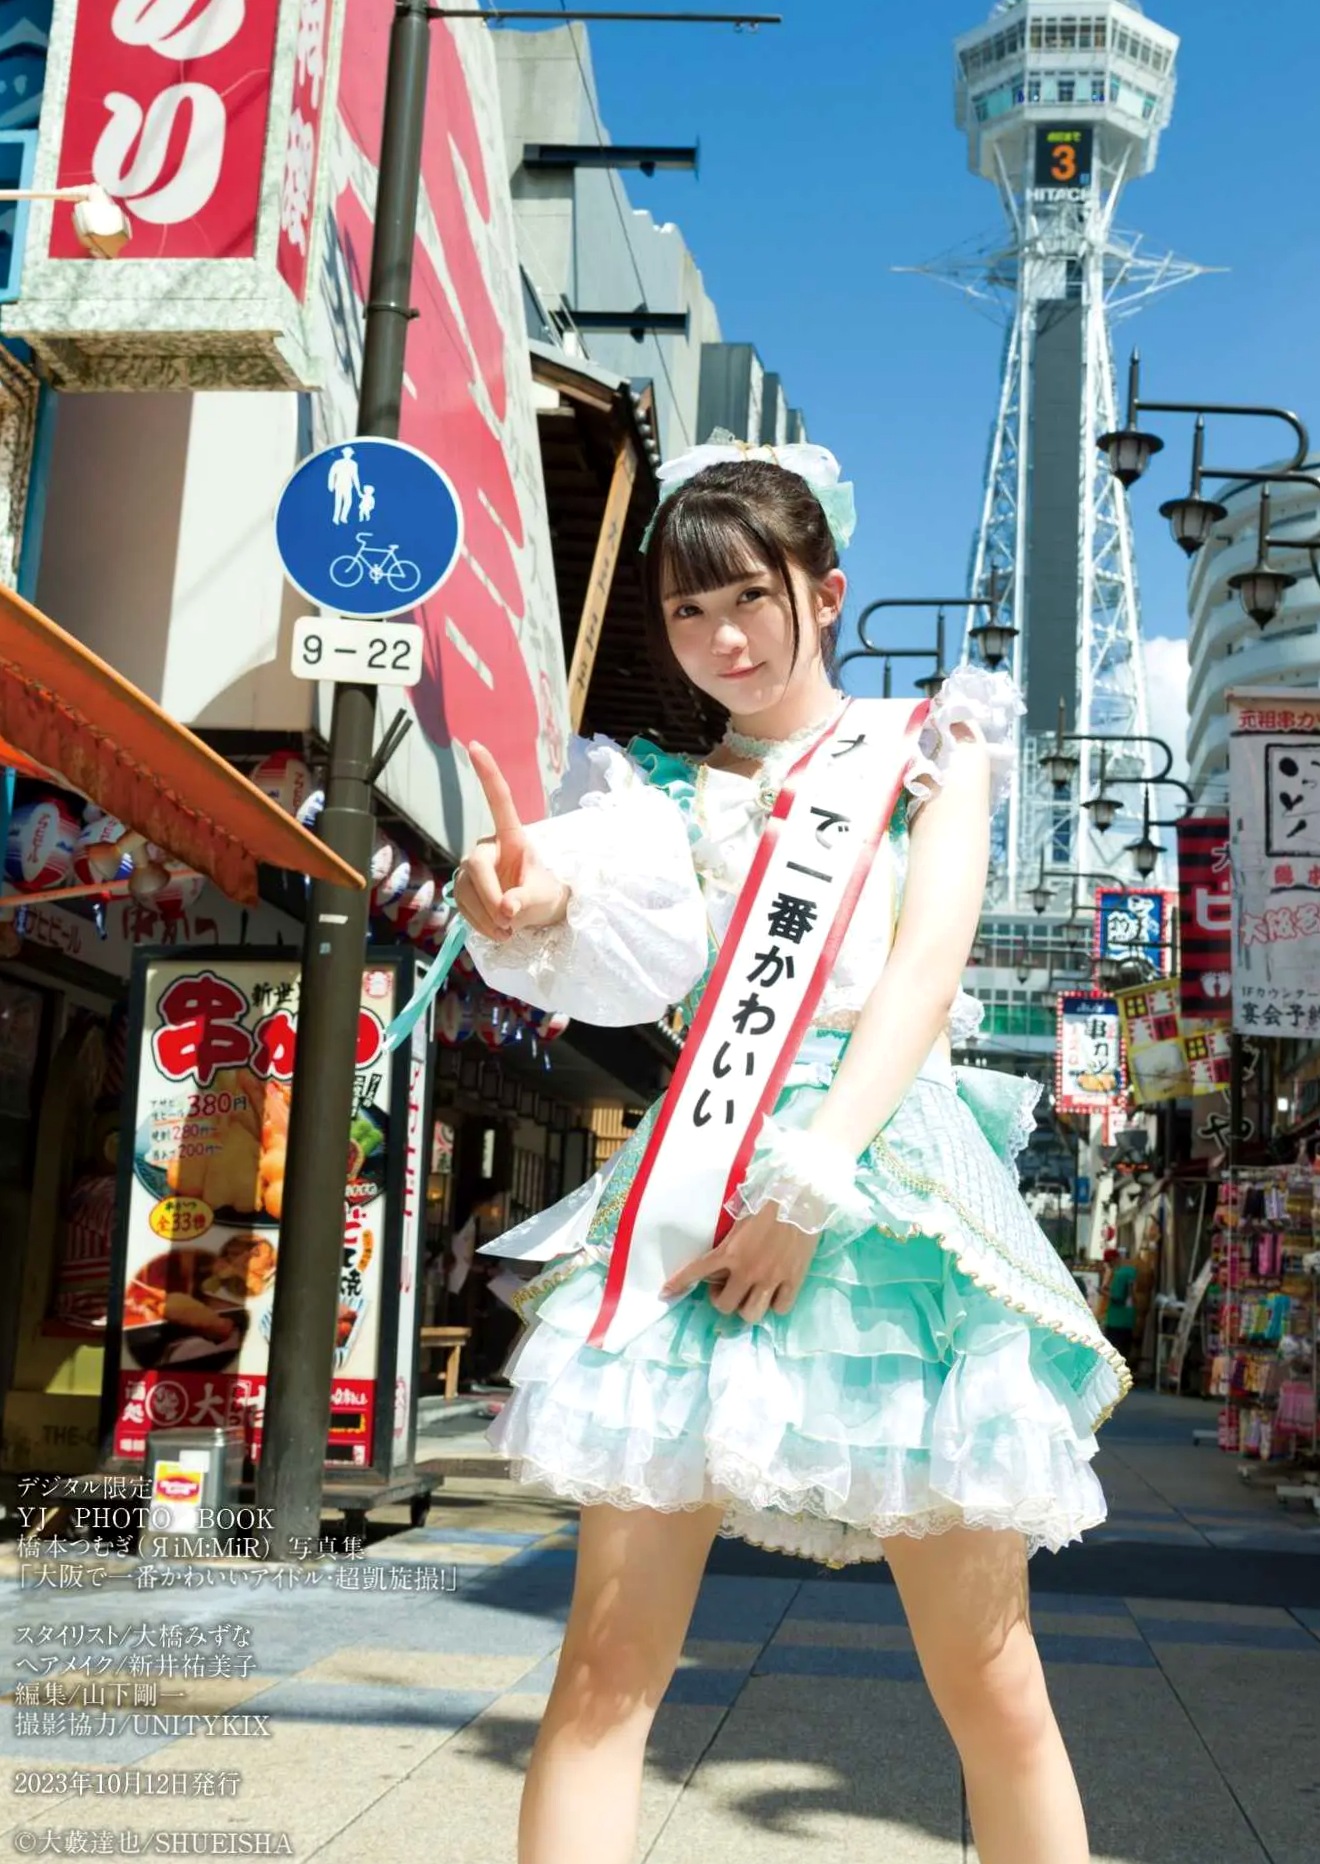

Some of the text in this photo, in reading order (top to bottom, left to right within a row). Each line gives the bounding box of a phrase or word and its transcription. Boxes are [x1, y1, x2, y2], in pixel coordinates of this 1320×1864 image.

[1051, 144, 1076, 181] 3
[1239, 710, 1320, 729] 元祖串カ
